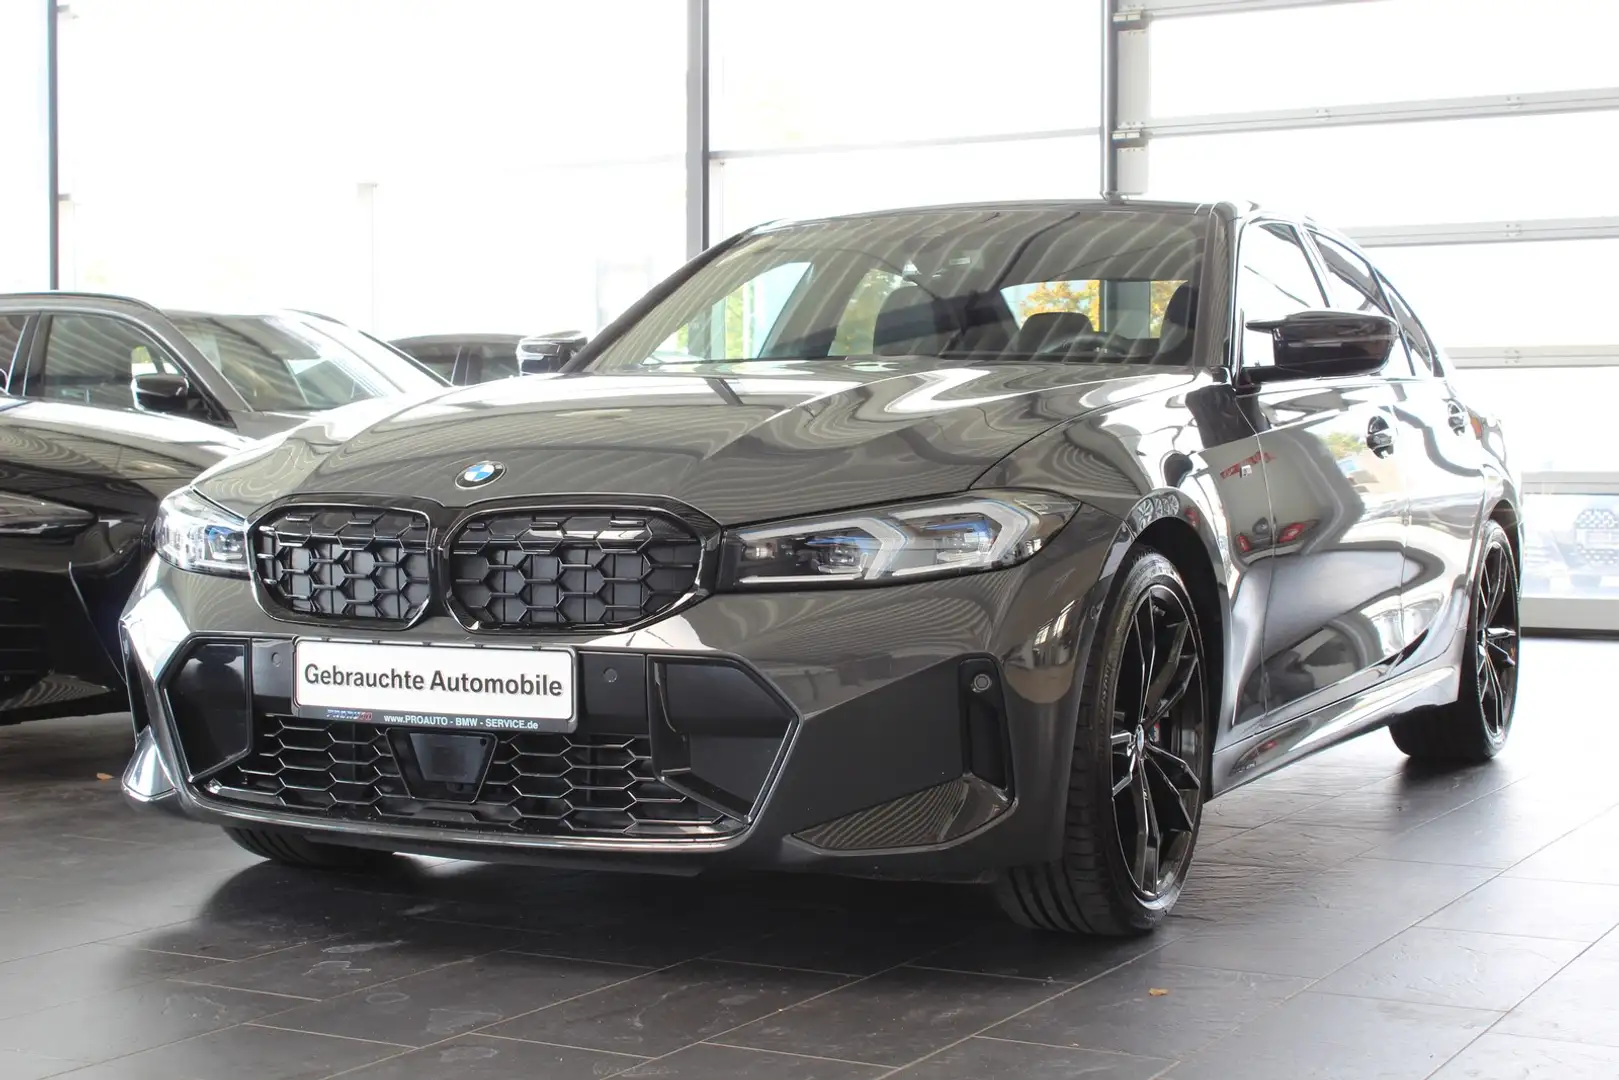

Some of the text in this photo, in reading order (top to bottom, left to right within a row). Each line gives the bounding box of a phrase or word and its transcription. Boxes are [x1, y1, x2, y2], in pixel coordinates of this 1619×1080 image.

[304, 663, 563, 696] Gebrauchte Automobile
[383, 715, 448, 726] www.PROAUTO
[455, 717, 478, 727] BMW
[485, 718, 539, 729] SERVICE.de
